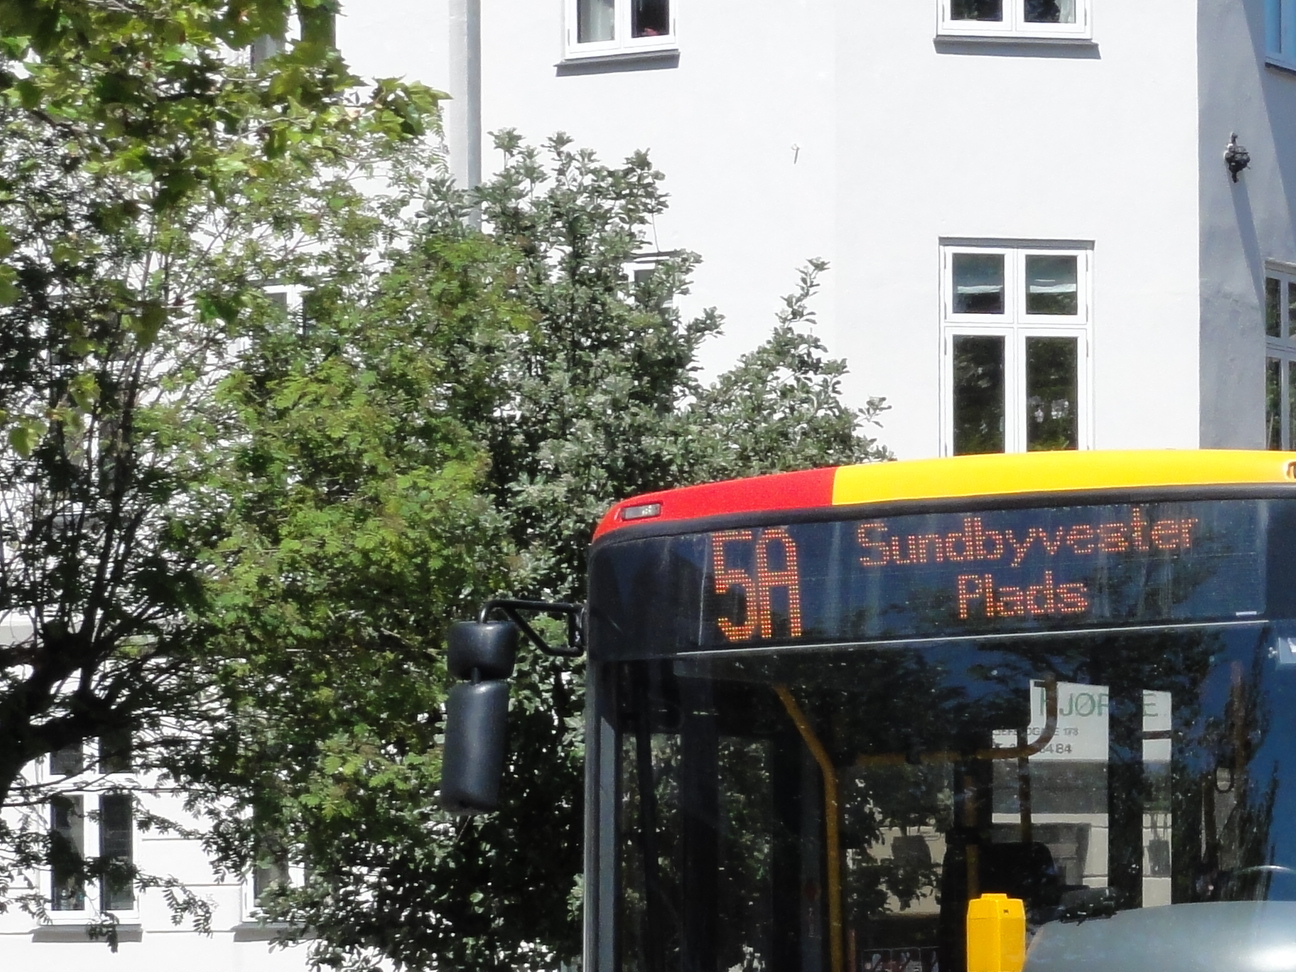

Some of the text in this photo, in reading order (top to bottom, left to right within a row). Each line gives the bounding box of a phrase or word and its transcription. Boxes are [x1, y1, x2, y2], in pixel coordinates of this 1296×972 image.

[856, 507, 1199, 568] Sundbyvester
[712, 525, 802, 643] 5A
[957, 571, 1089, 619] Plads
